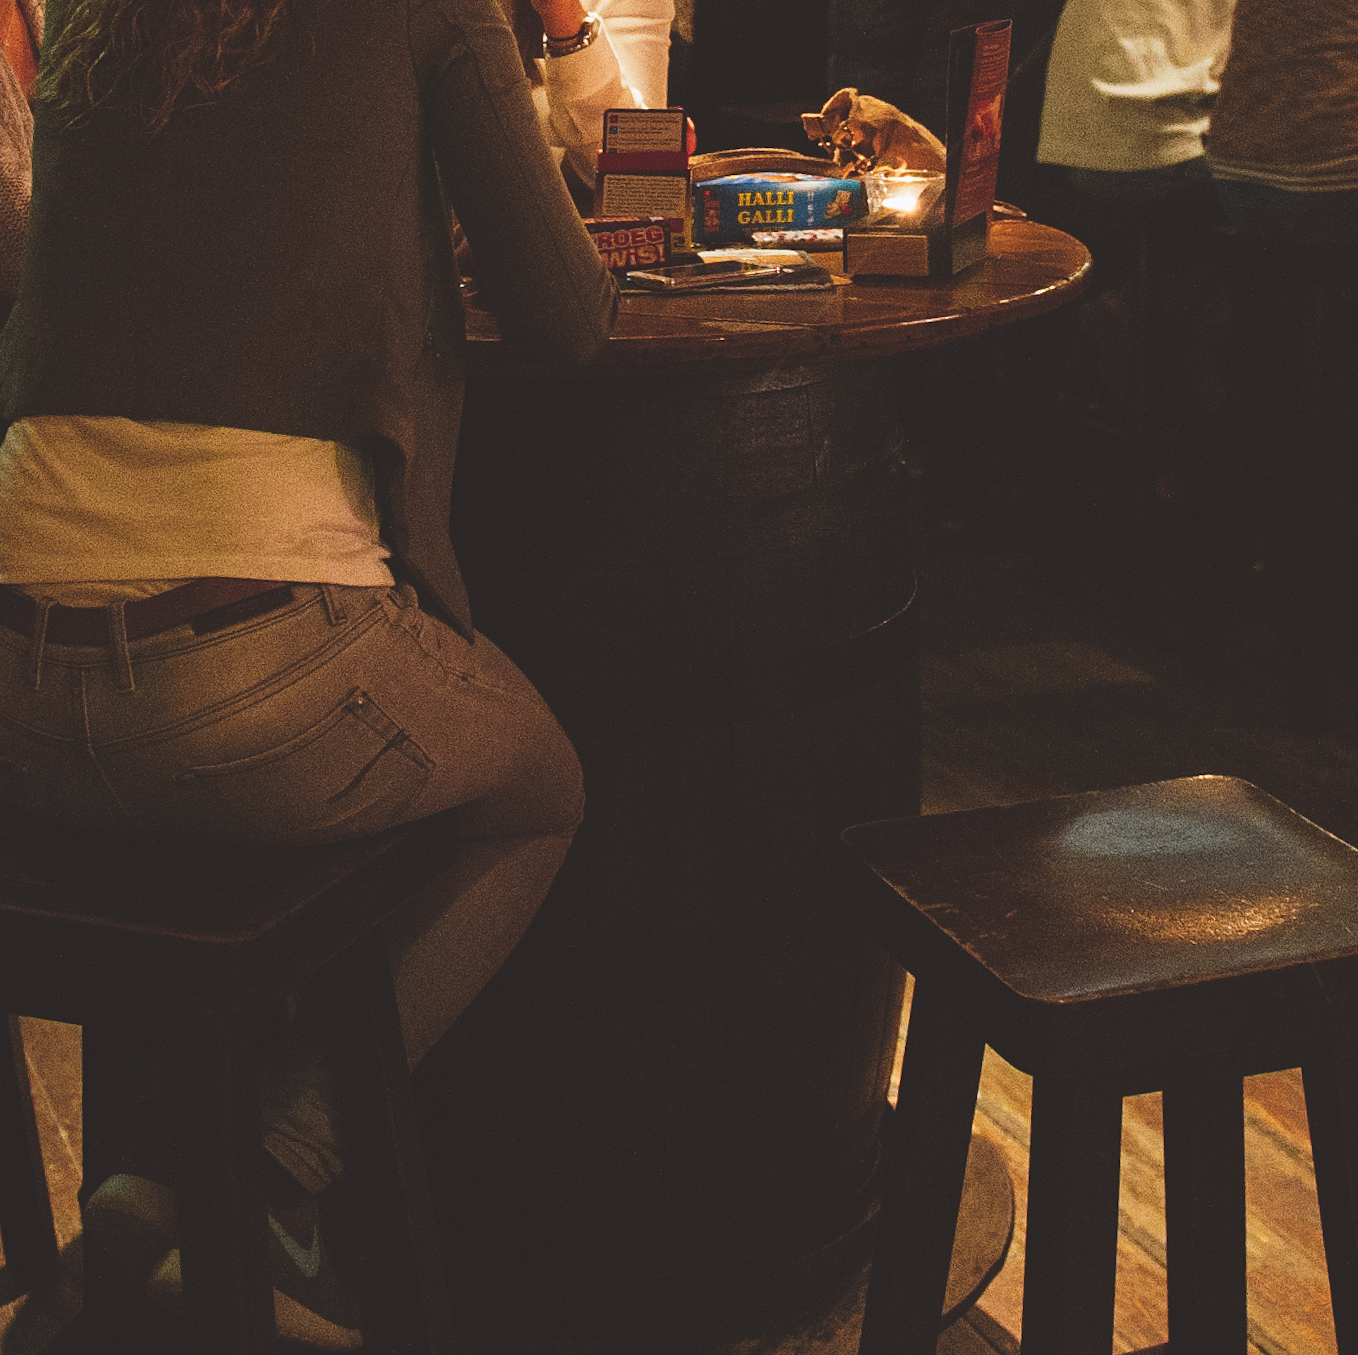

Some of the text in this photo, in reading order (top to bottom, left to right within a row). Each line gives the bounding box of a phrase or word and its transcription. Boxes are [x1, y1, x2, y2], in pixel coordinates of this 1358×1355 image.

[737, 190, 795, 207] HALLI
[737, 208, 795, 225] GALLI
[593, 224, 665, 252] ROEG
[601, 245, 666, 270] WiS!
